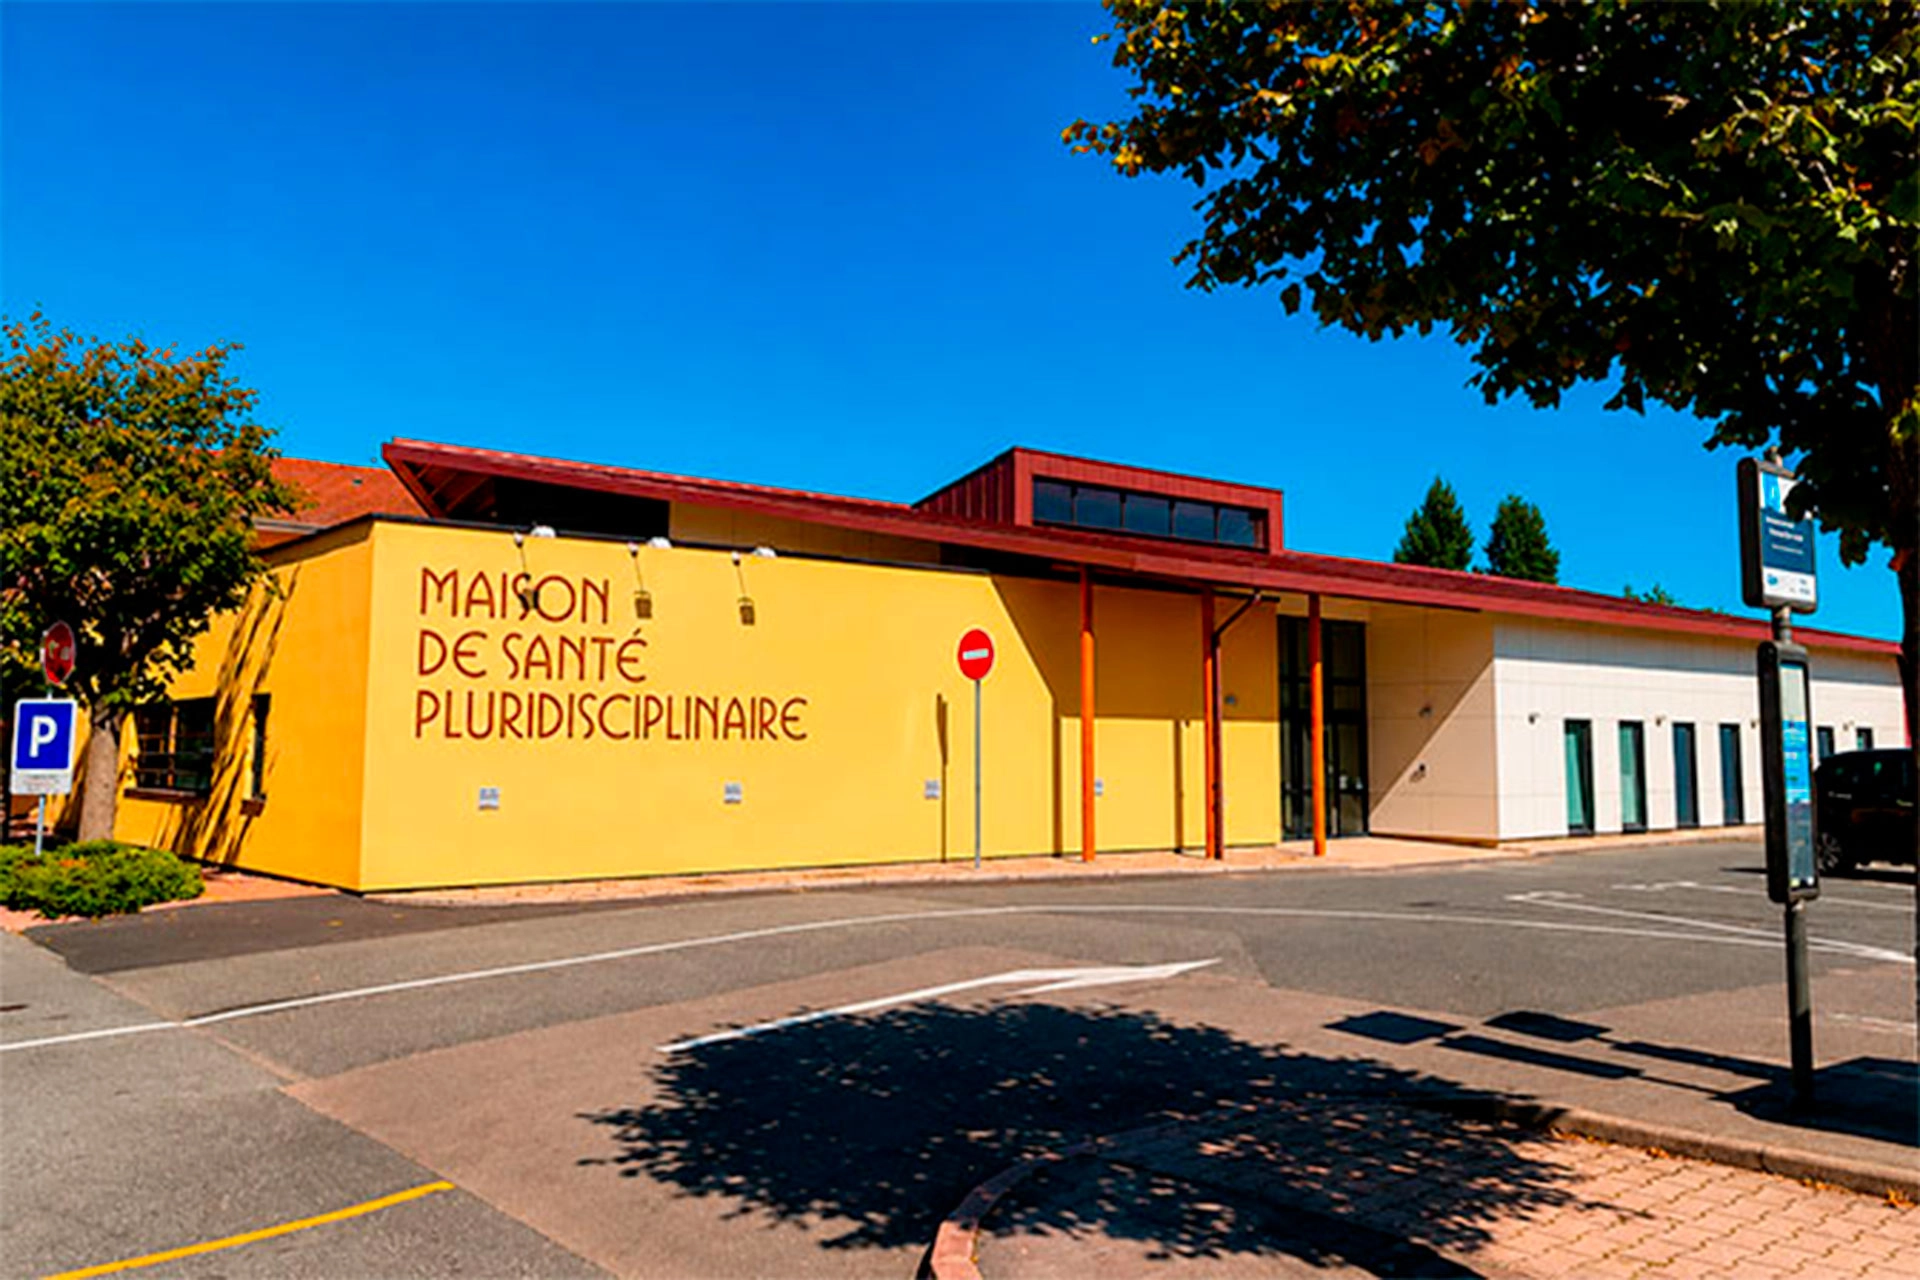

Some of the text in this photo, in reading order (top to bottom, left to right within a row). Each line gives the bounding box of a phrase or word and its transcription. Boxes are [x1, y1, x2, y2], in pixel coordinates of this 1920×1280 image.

[420, 567, 609, 624] MAISON
[419, 629, 648, 682] DE SANTÉ
[29, 715, 57, 758] P
[415, 690, 808, 740] PLURIDISCIPLINAIRE
